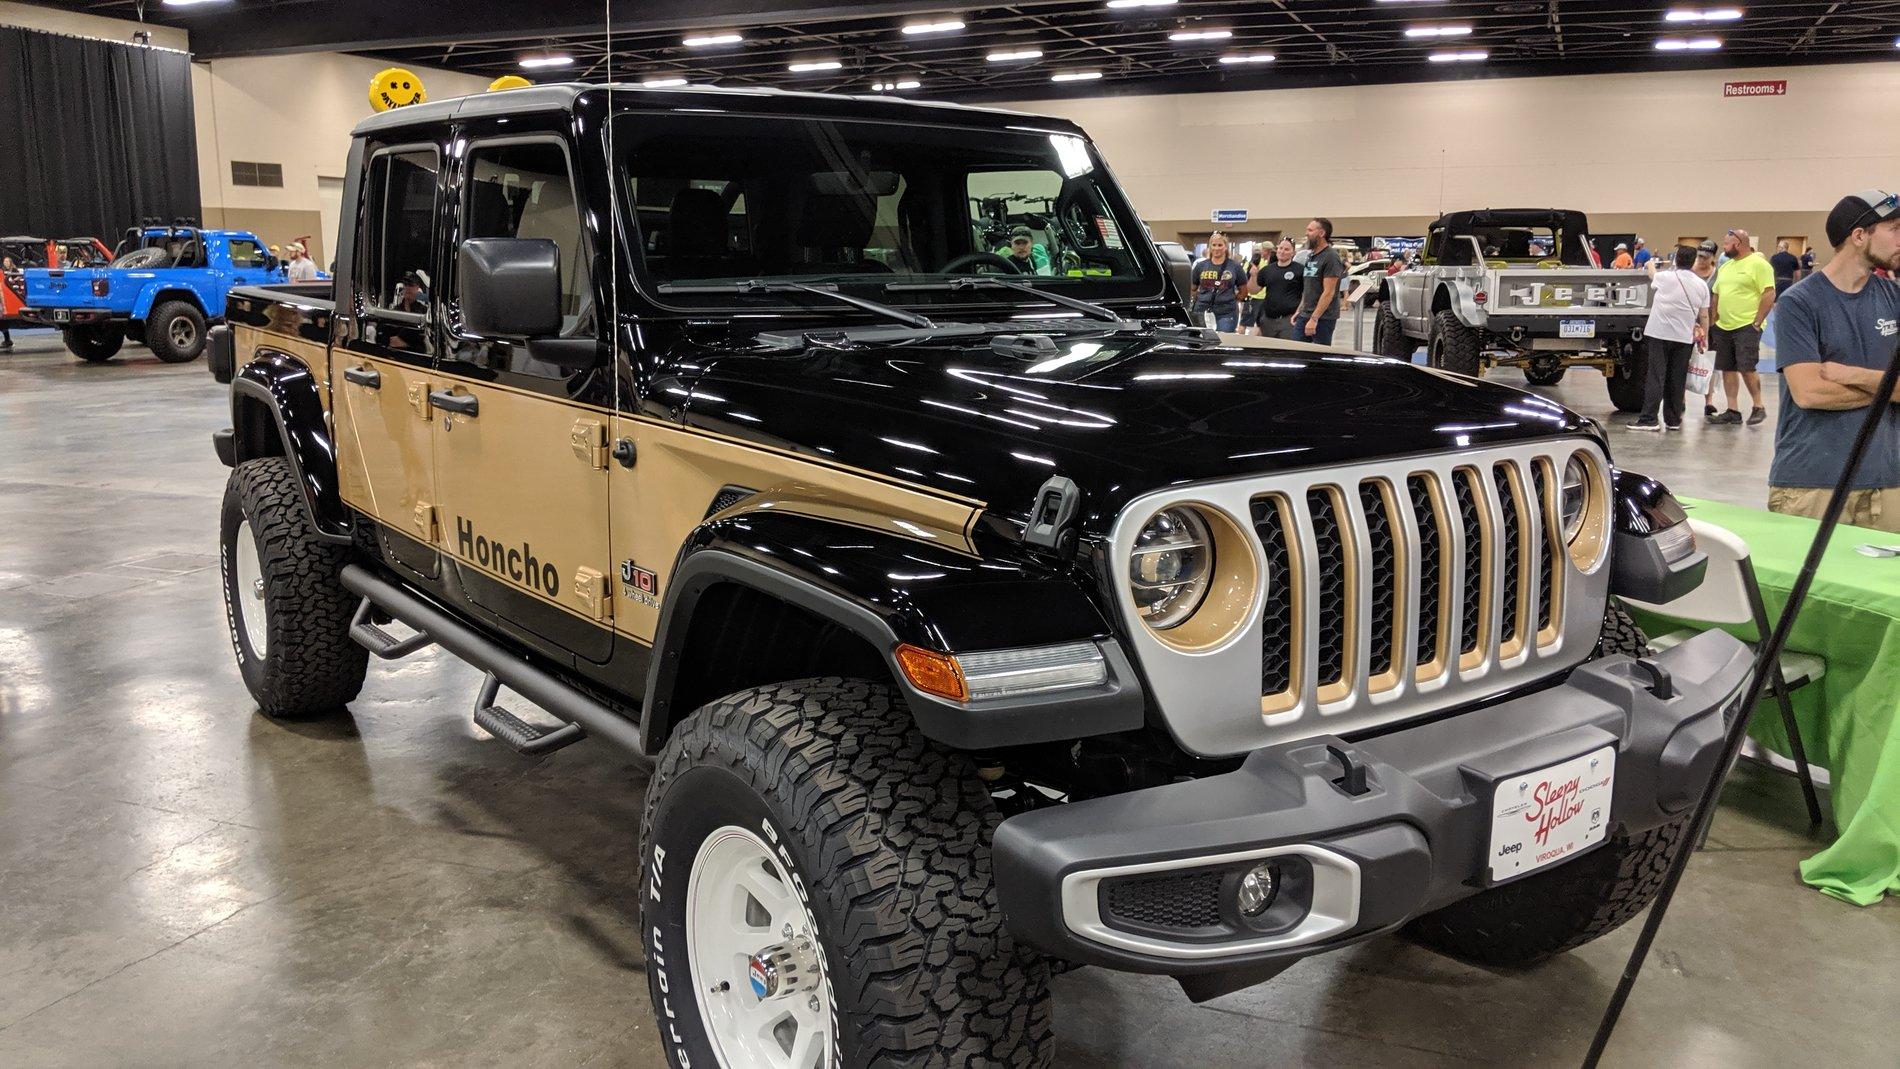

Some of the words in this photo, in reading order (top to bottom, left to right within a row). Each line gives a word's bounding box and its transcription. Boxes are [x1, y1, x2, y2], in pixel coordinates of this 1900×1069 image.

[1725, 85, 1775, 95] Restrooms
[1522, 282, 1637, 306] Jeep
[456, 515, 560, 597] Honcho
[1525, 775, 1581, 822] Sleepy
[1534, 797, 1585, 847] Hollow
[1498, 841, 1523, 857] Jeep
[650, 844, 667, 903] T/A
